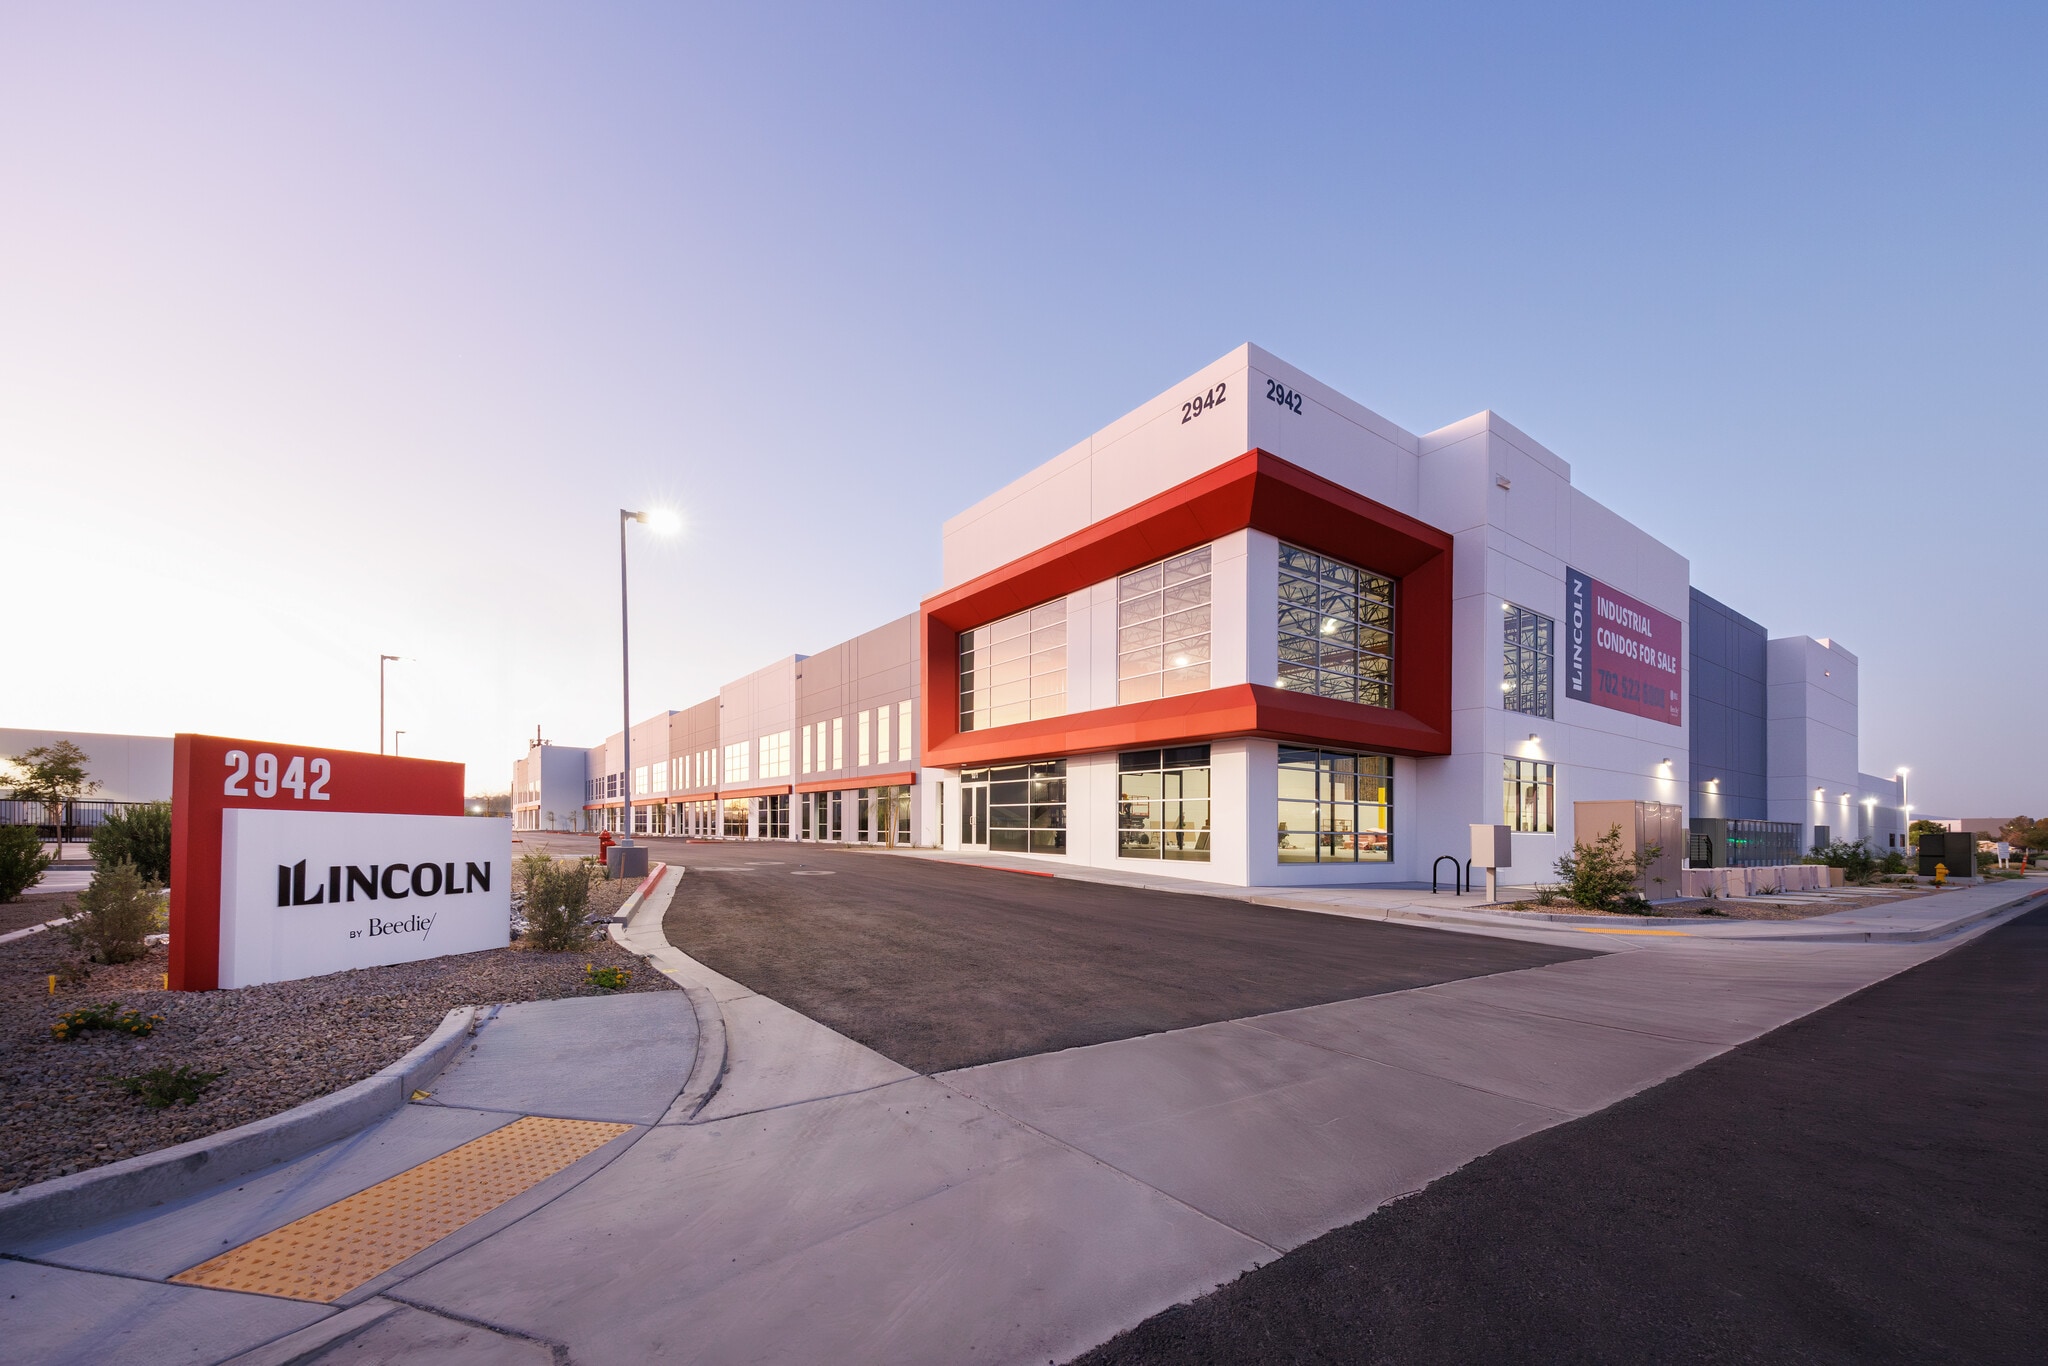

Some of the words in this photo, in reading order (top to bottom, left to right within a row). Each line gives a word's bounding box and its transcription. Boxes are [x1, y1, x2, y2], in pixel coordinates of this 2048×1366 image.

[1181, 382, 1227, 424] 2942
[1266, 379, 1303, 415] 2942
[1572, 579, 1583, 691] LINCOLN
[1597, 596, 1652, 637] INDUSTRIAL
[1597, 627, 1637, 660] CONDOS
[1639, 643, 1656, 667] FOR
[1657, 652, 1676, 674] SALE
[1598, 669, 1618, 696] 702
[224, 749, 331, 801] 2942
[277, 858, 491, 907] LINCOLN
[350, 930, 362, 938] BY
